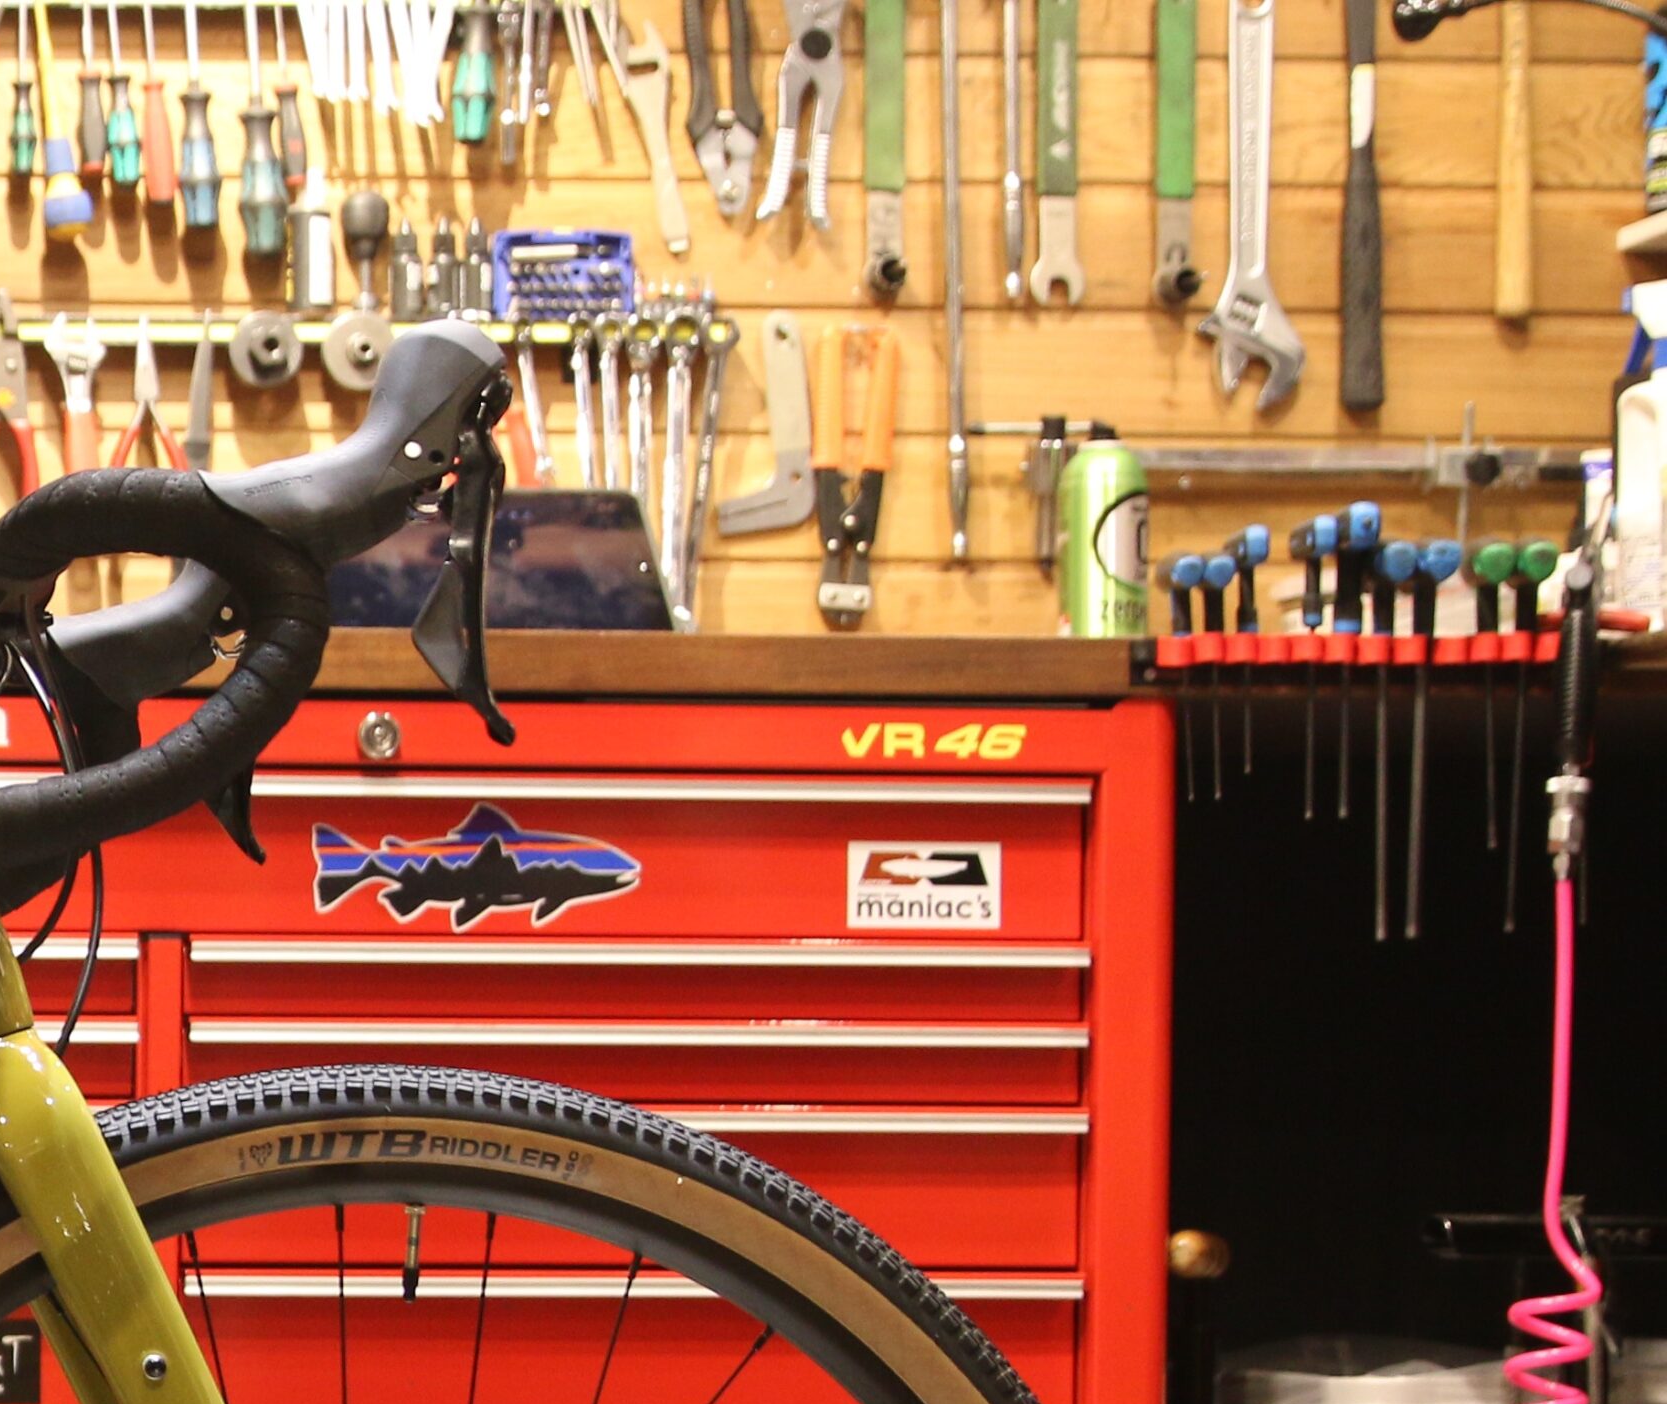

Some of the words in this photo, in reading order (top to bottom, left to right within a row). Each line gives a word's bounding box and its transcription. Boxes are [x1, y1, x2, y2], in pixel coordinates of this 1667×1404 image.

[934, 723, 1028, 759] 46
[278, 1130, 427, 1165] WTB
[430, 1136, 561, 1170] RIDDLER
